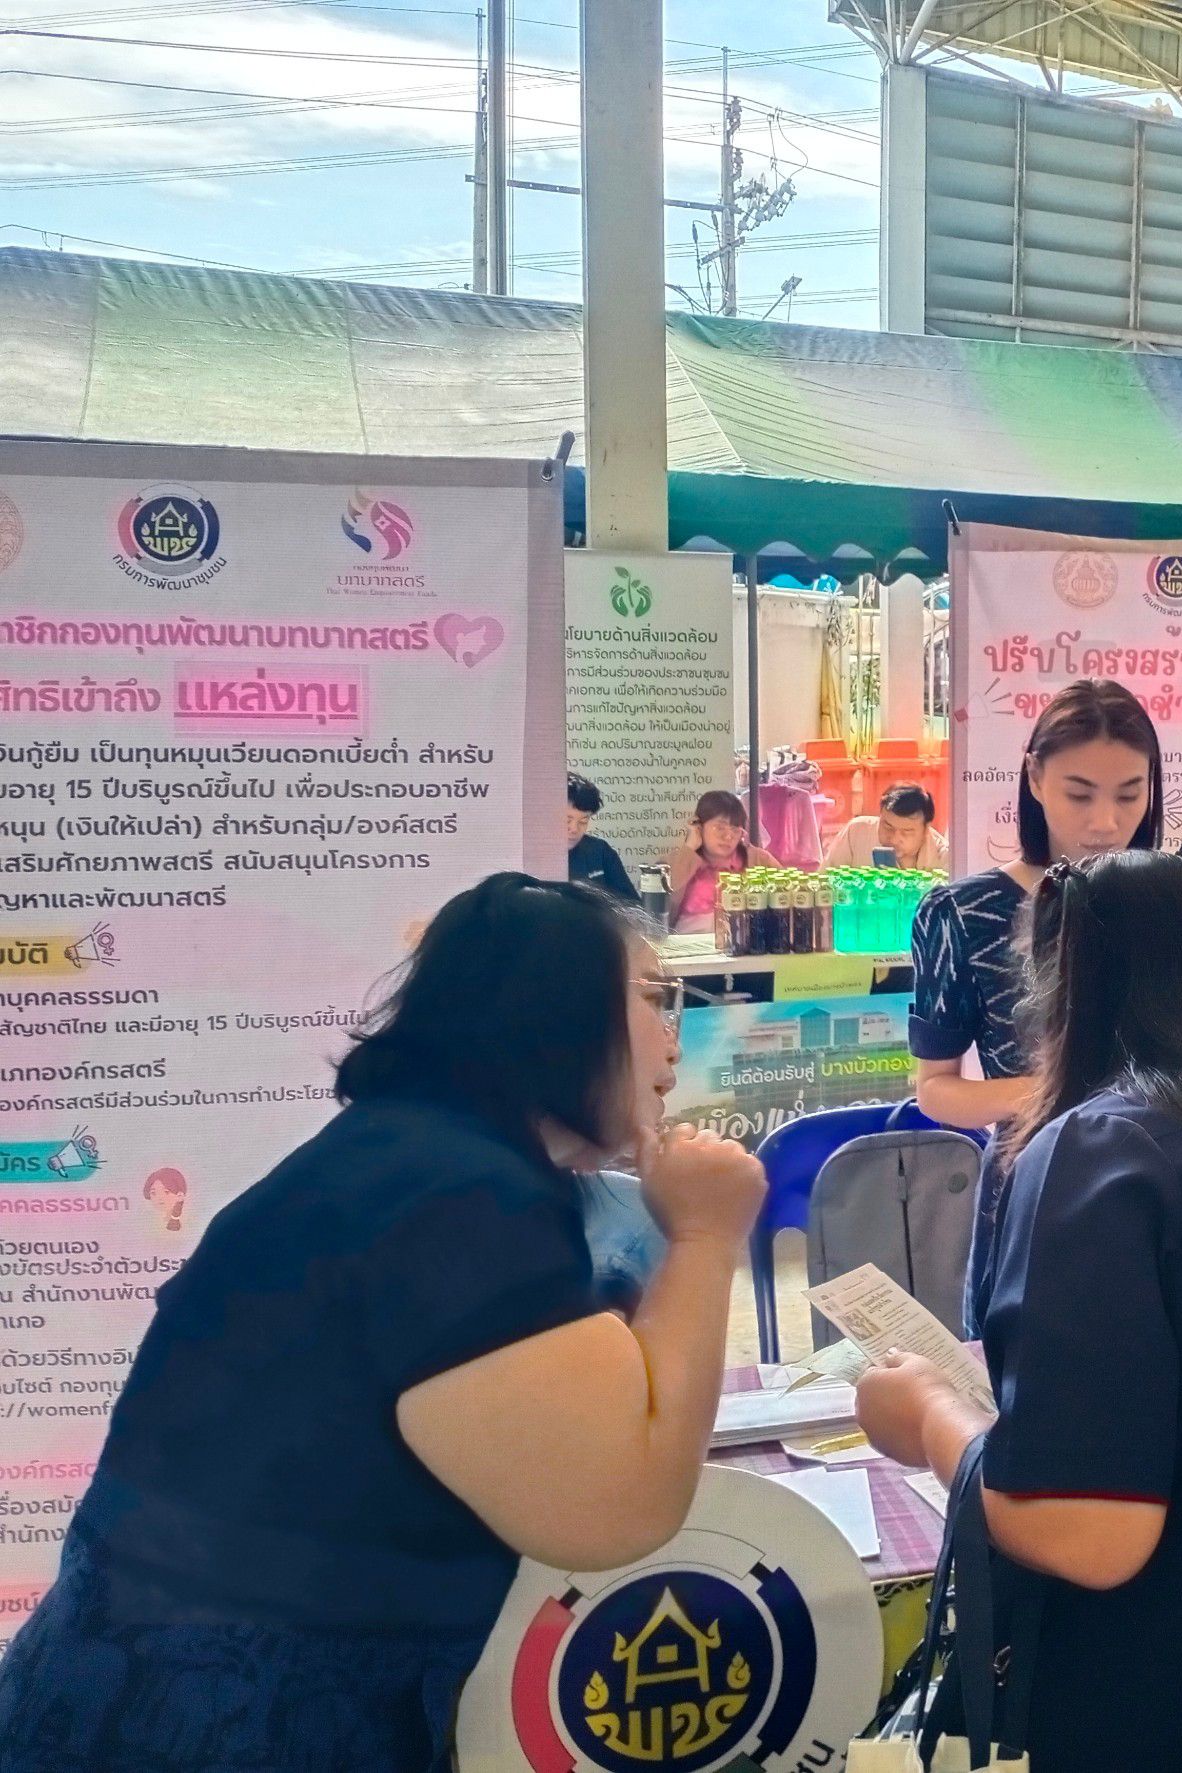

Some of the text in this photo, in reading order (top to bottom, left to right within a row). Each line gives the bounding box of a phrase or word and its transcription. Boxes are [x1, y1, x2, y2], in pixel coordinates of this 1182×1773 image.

[176, 667, 358, 725] แหล่งทุน
[91, 738, 408, 769] เป็นทุนหมุนเวียนดอกเบี้ยต่ำ
[419, 742, 494, 765] สำหรับ
[66, 779, 92, 799] 15
[103, 771, 275, 805] ปีบริบูรณ์ขึ้นไป
[286, 772, 490, 799] เพื่อประกอบอาชีพ
[57, 814, 202, 841] (เงินให้เปล่า)
[212, 813, 458, 842] สำหรับกลุ่ม/องค์สตรี
[224, 850, 431, 876] สนับสนุนโครงการ
[115, 1015, 199, 1037] และมีอายุ
[207, 1014, 227, 1031] 15
[720, 1055, 914, 1087] ยินดีต้อนรับสู่ บางบัวทอง
[0, 1400, 111, 1418] ://womenf
